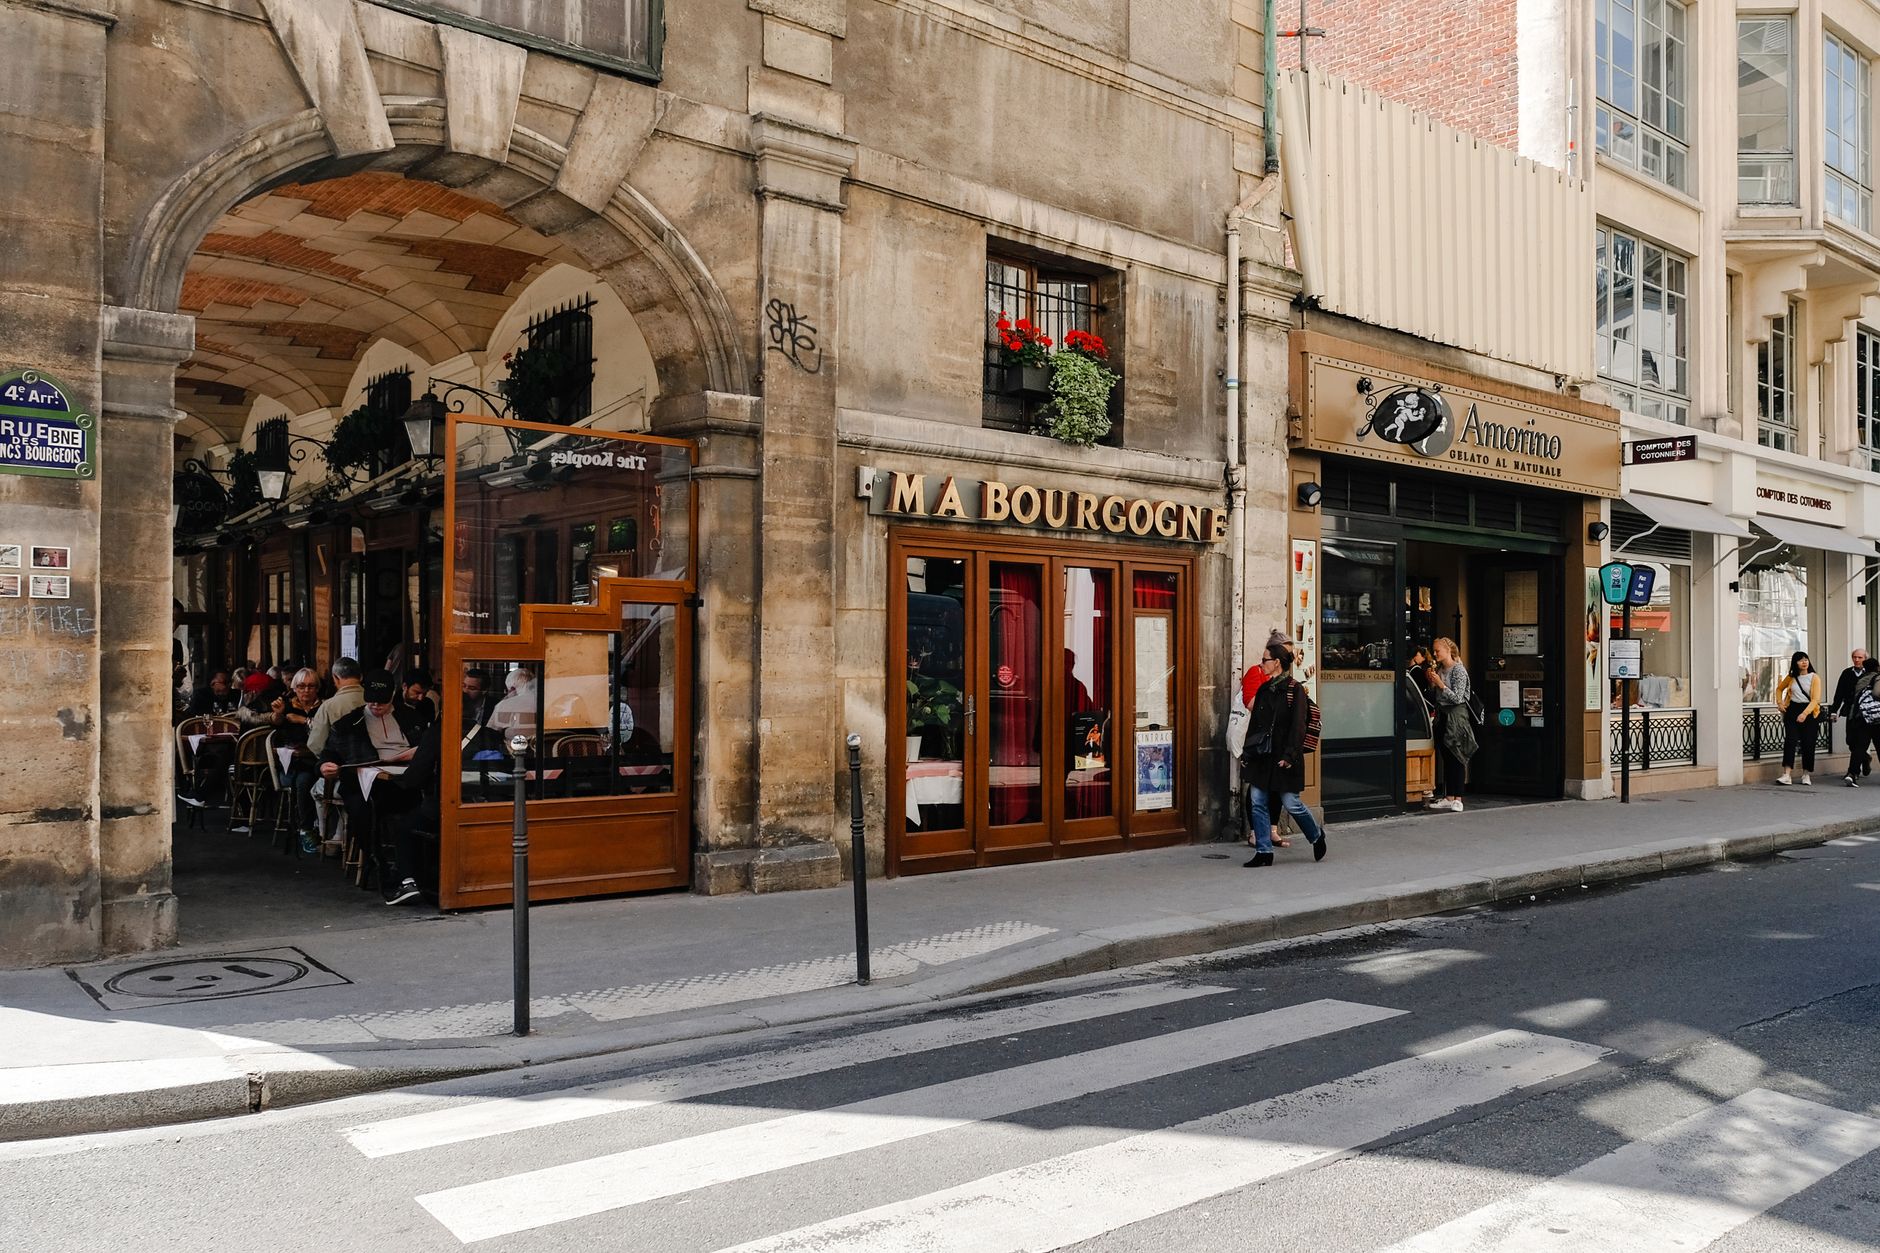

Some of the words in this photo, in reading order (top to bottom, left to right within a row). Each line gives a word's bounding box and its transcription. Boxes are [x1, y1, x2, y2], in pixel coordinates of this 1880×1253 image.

[1, 420, 48, 439] RUE
[51, 429, 79, 446] BNE
[1458, 402, 1562, 460] Amorino
[12, 436, 39, 446] DES
[1636, 442, 1673, 452] COMPTOIR
[1676, 440, 1691, 448] DES
[25, 446, 81, 463] BOURGEOIS
[1449, 449, 1490, 466] GELATO
[1496, 456, 1508, 469] AL
[1513, 460, 1562, 478] NATURALE
[1640, 449, 1686, 460] COTONNIERS
[1756, 486, 1786, 502] COMPTOIR
[1787, 492, 1799, 504] DES
[1799, 495, 1832, 511] COTONNIERS
[978, 480, 1229, 544] BOURGOGNE
